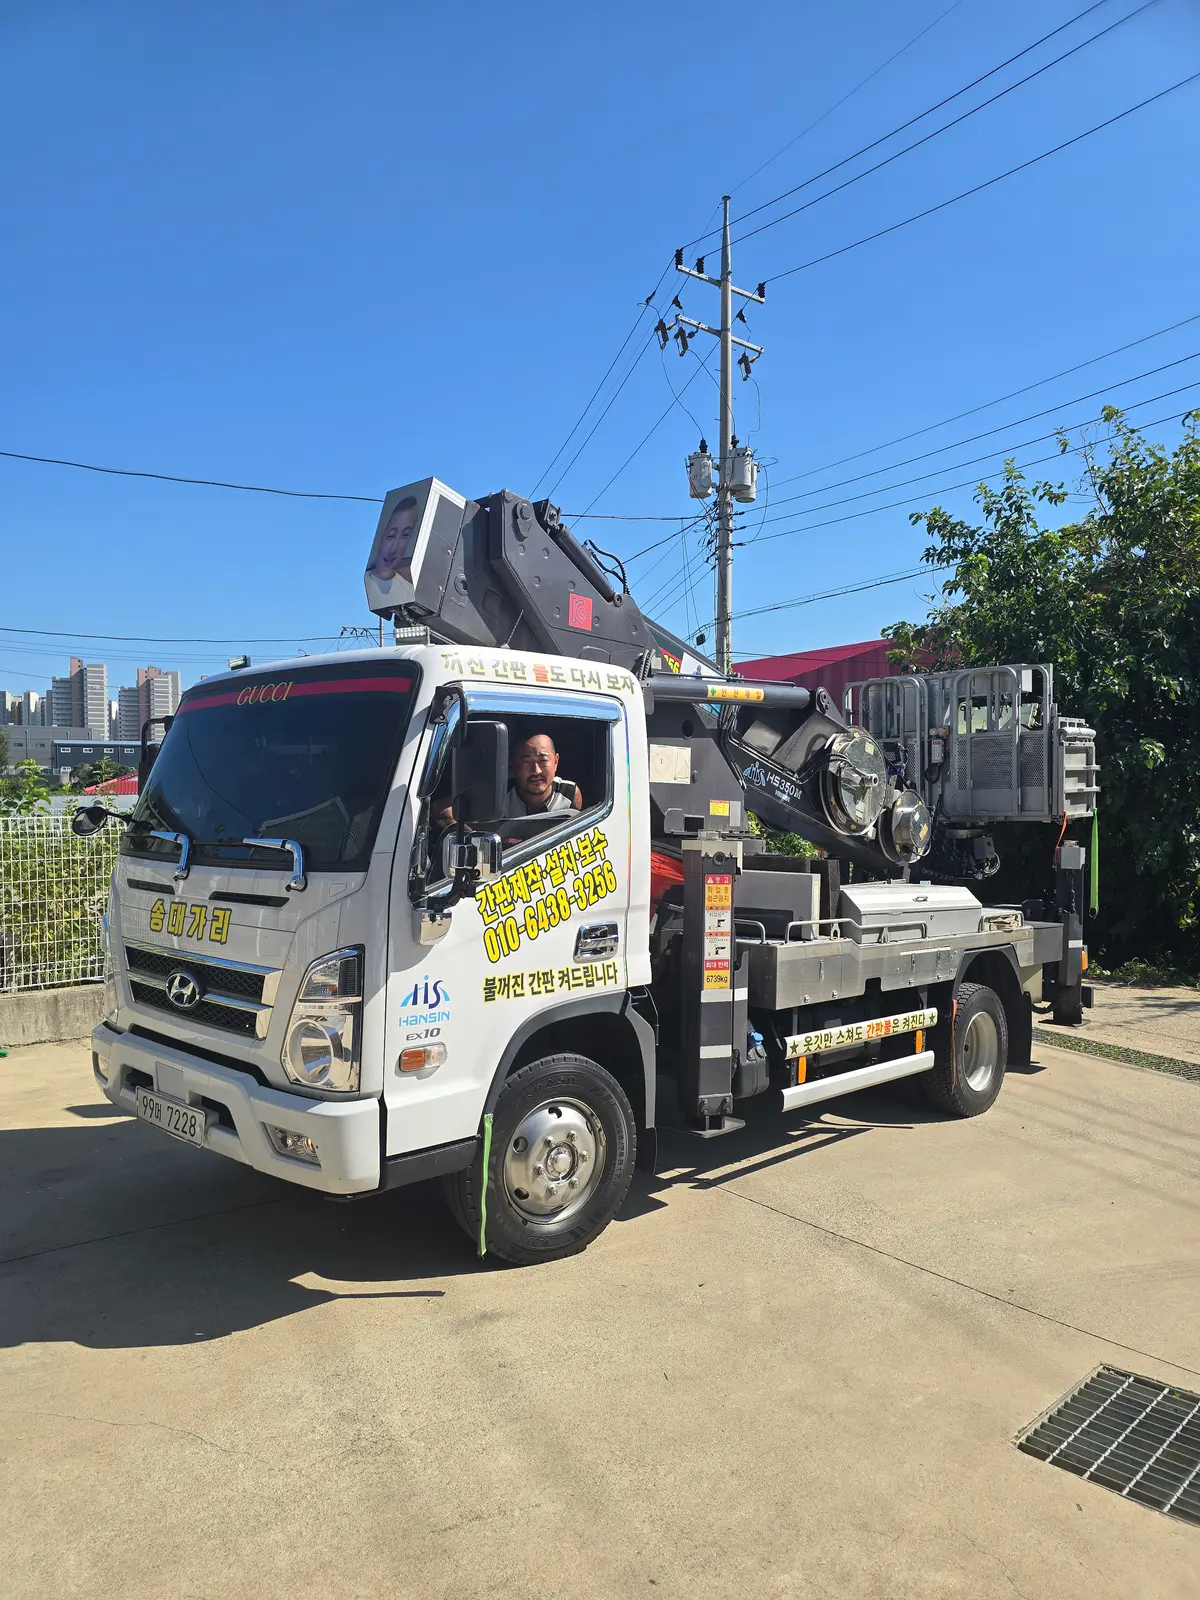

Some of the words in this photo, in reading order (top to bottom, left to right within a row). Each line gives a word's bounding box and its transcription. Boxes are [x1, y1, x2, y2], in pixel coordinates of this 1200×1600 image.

[237, 681, 294, 706] GUCCI
[491, 657, 528, 680] 간판
[570, 667, 602, 690] 다시
[606, 672, 635, 694] 보자
[149, 898, 232, 945] 송대가리
[483, 860, 617, 963] 010-6438-3256
[483, 972, 525, 1002] 불꺼진
[528, 969, 555, 997] 간판
[558, 961, 618, 991] 켜드립니다
[706, 975, 728, 983] 6739kg
[803, 1033, 833, 1053] 옷깃만
[836, 1026, 863, 1045] 스쳐도
[866, 1018, 900, 1039] 간판불은
[902, 1012, 926, 1030] 켜진다
[167, 1105, 197, 1137] 7228
